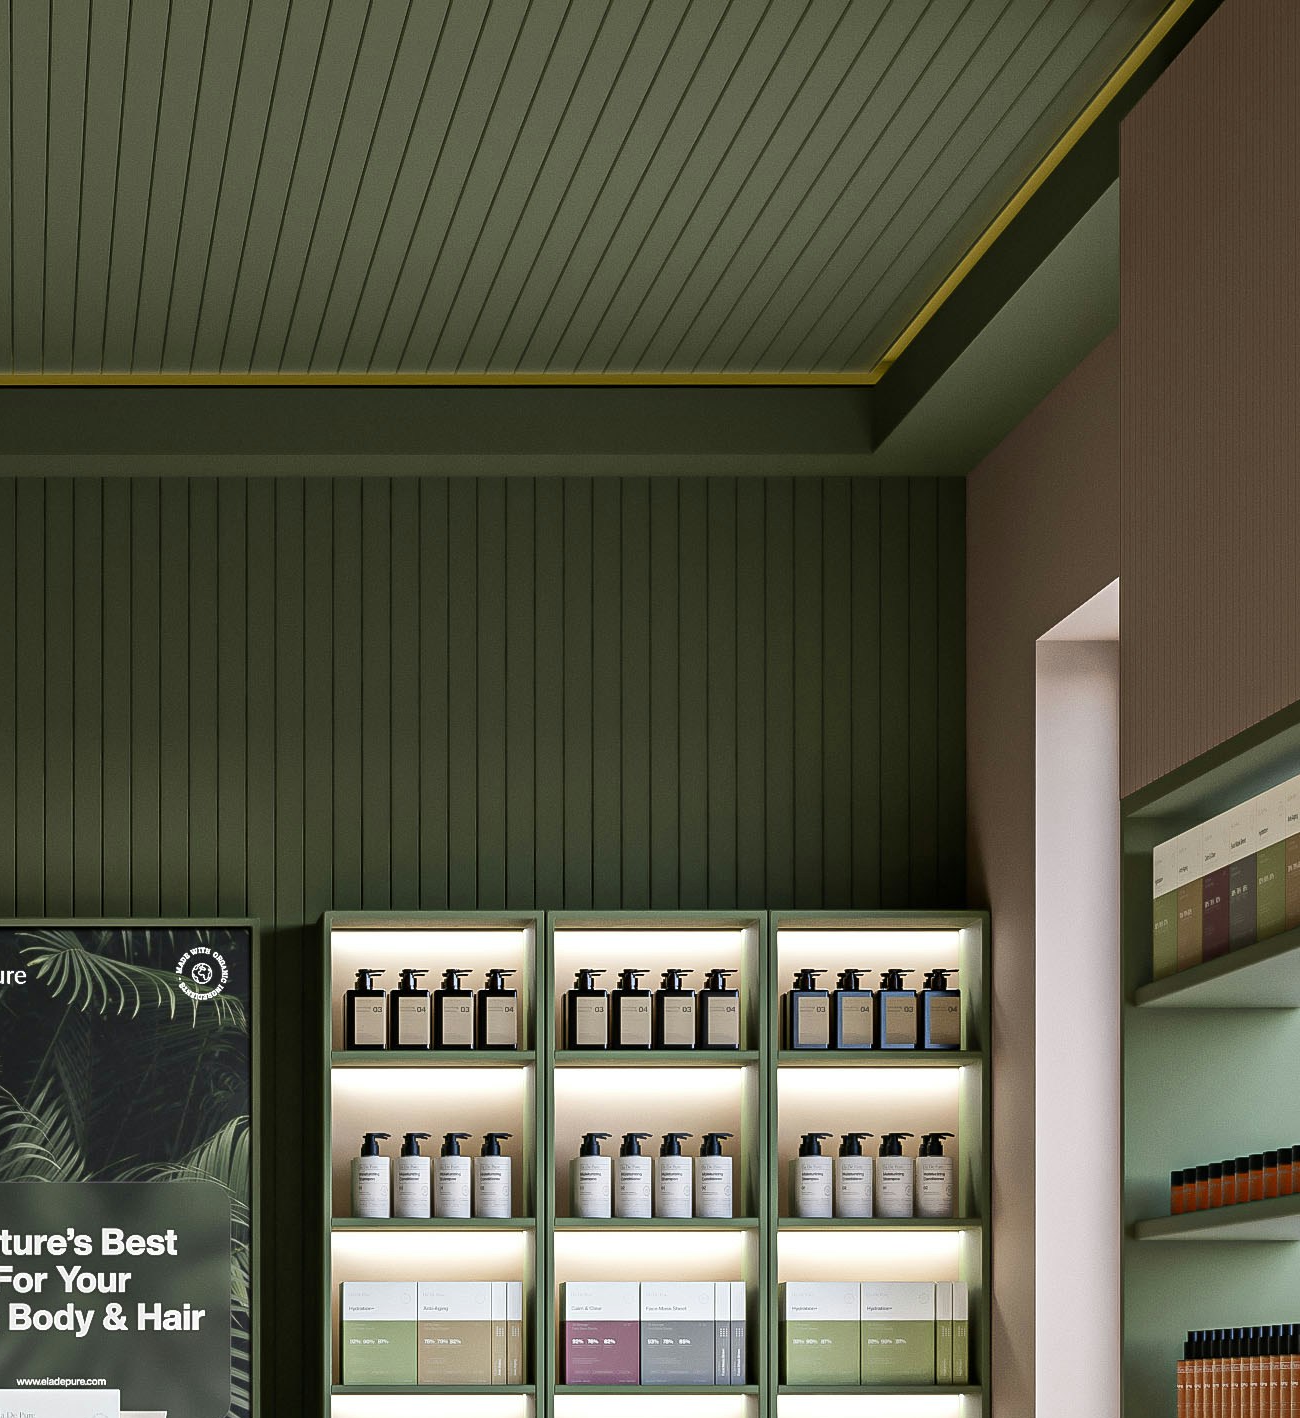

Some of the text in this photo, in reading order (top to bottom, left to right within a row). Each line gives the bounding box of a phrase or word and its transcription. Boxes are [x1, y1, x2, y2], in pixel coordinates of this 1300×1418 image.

[176, 946, 228, 1000] MADE WITH ORGANIC INGREDIENTS
[102, 1228, 178, 1256] Best
[56, 1266, 132, 1293] Your
[8, 1303, 95, 1338] Body
[102, 1302, 129, 1331] &
[138, 1303, 206, 1331] Hair
[16, 1377, 107, 1387] www.eladepure.com
